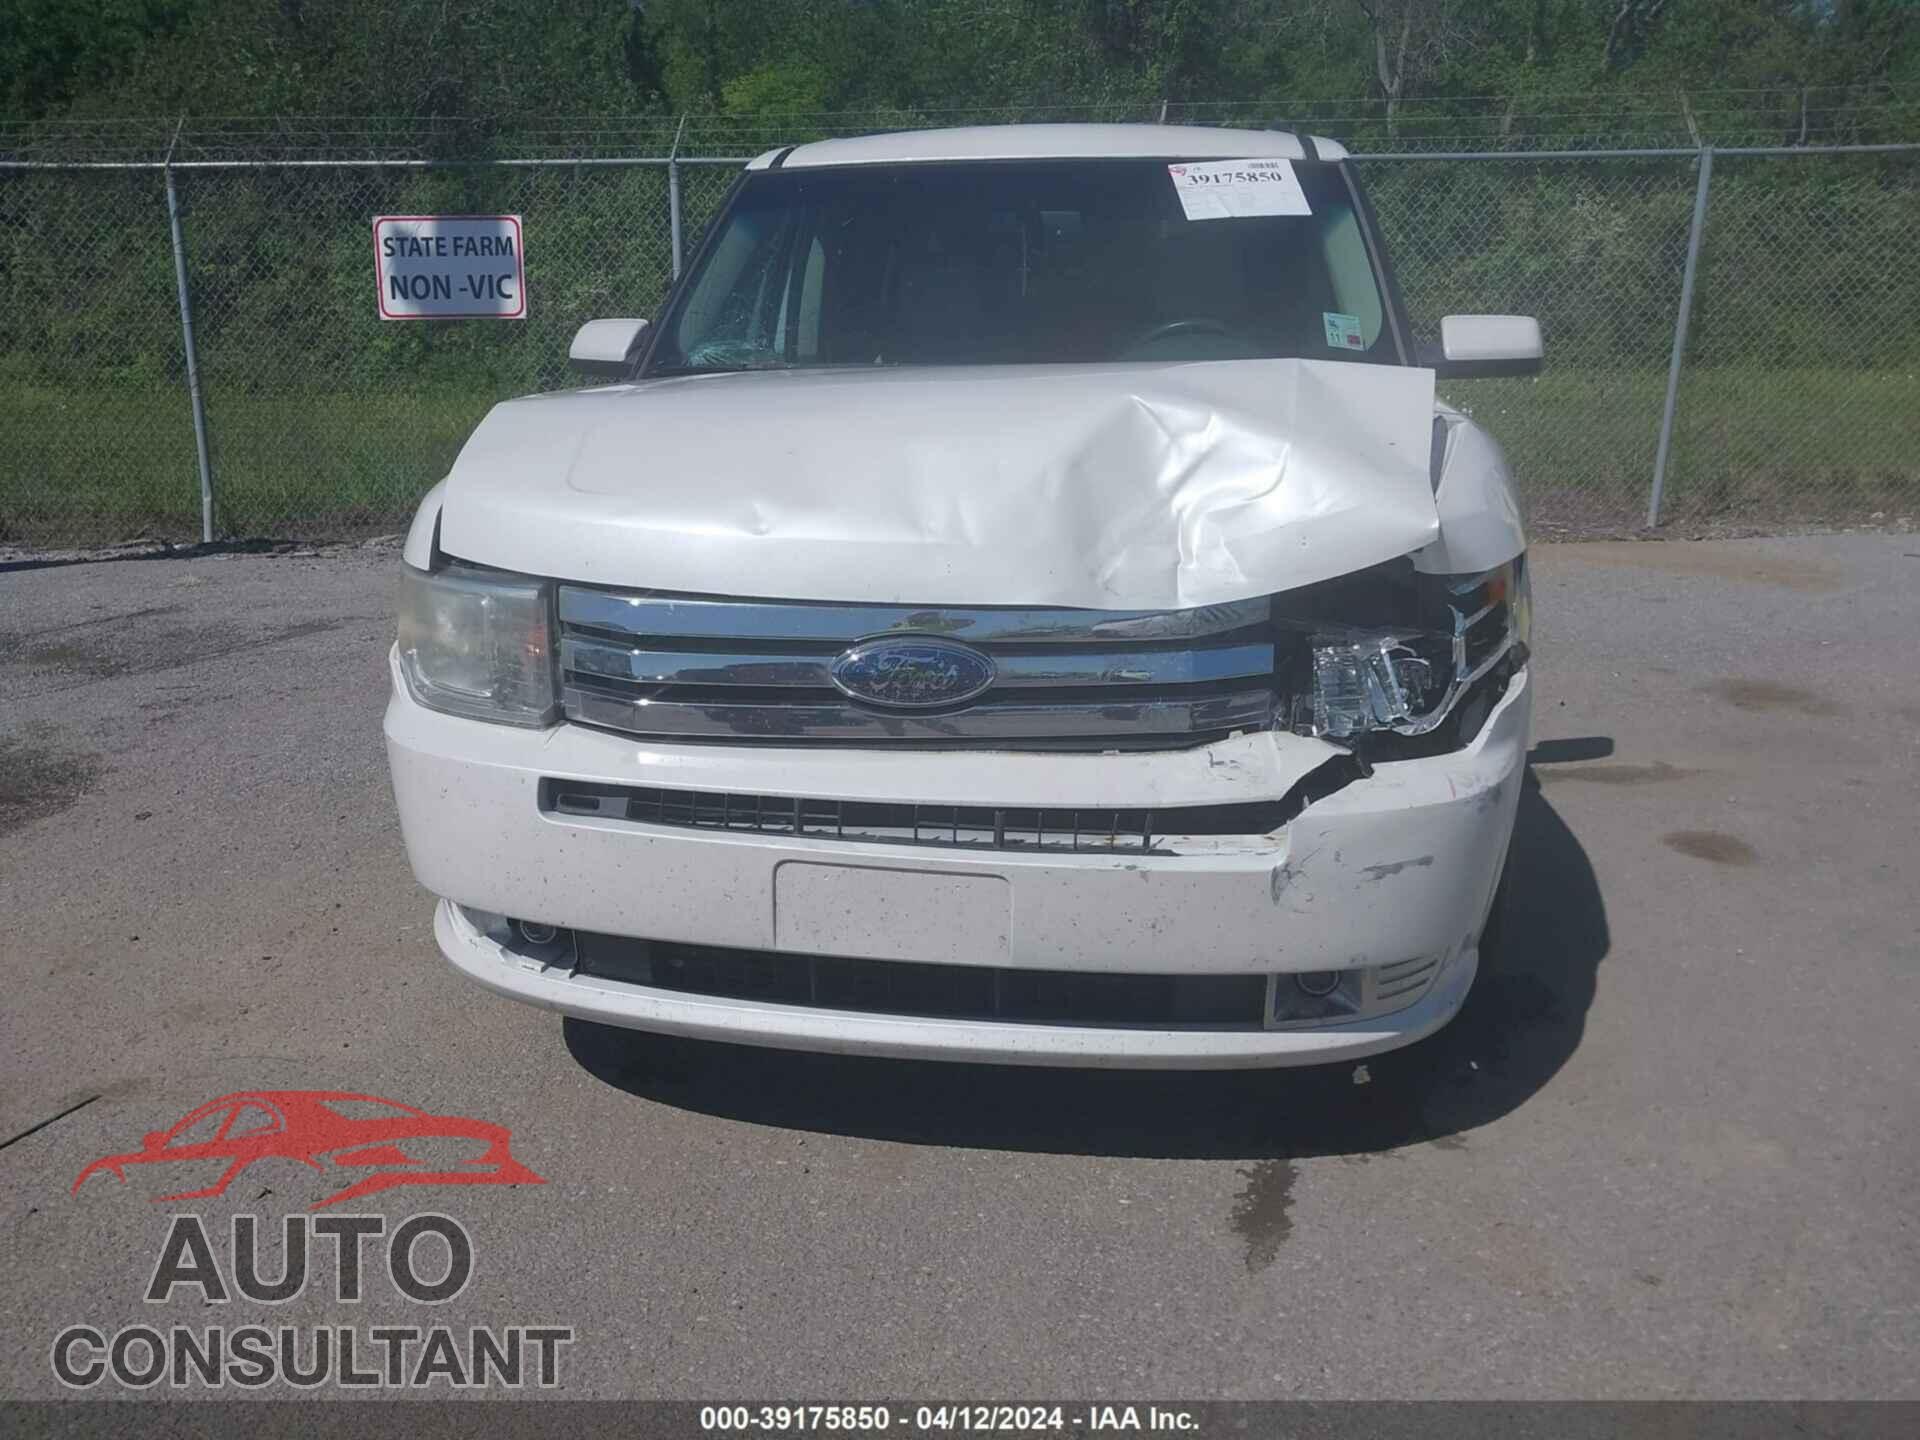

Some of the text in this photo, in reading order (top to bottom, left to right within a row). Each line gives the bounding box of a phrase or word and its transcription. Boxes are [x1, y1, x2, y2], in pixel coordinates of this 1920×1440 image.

[1187, 171, 1282, 186] 39175850
[383, 235, 514, 257] STATE FARM
